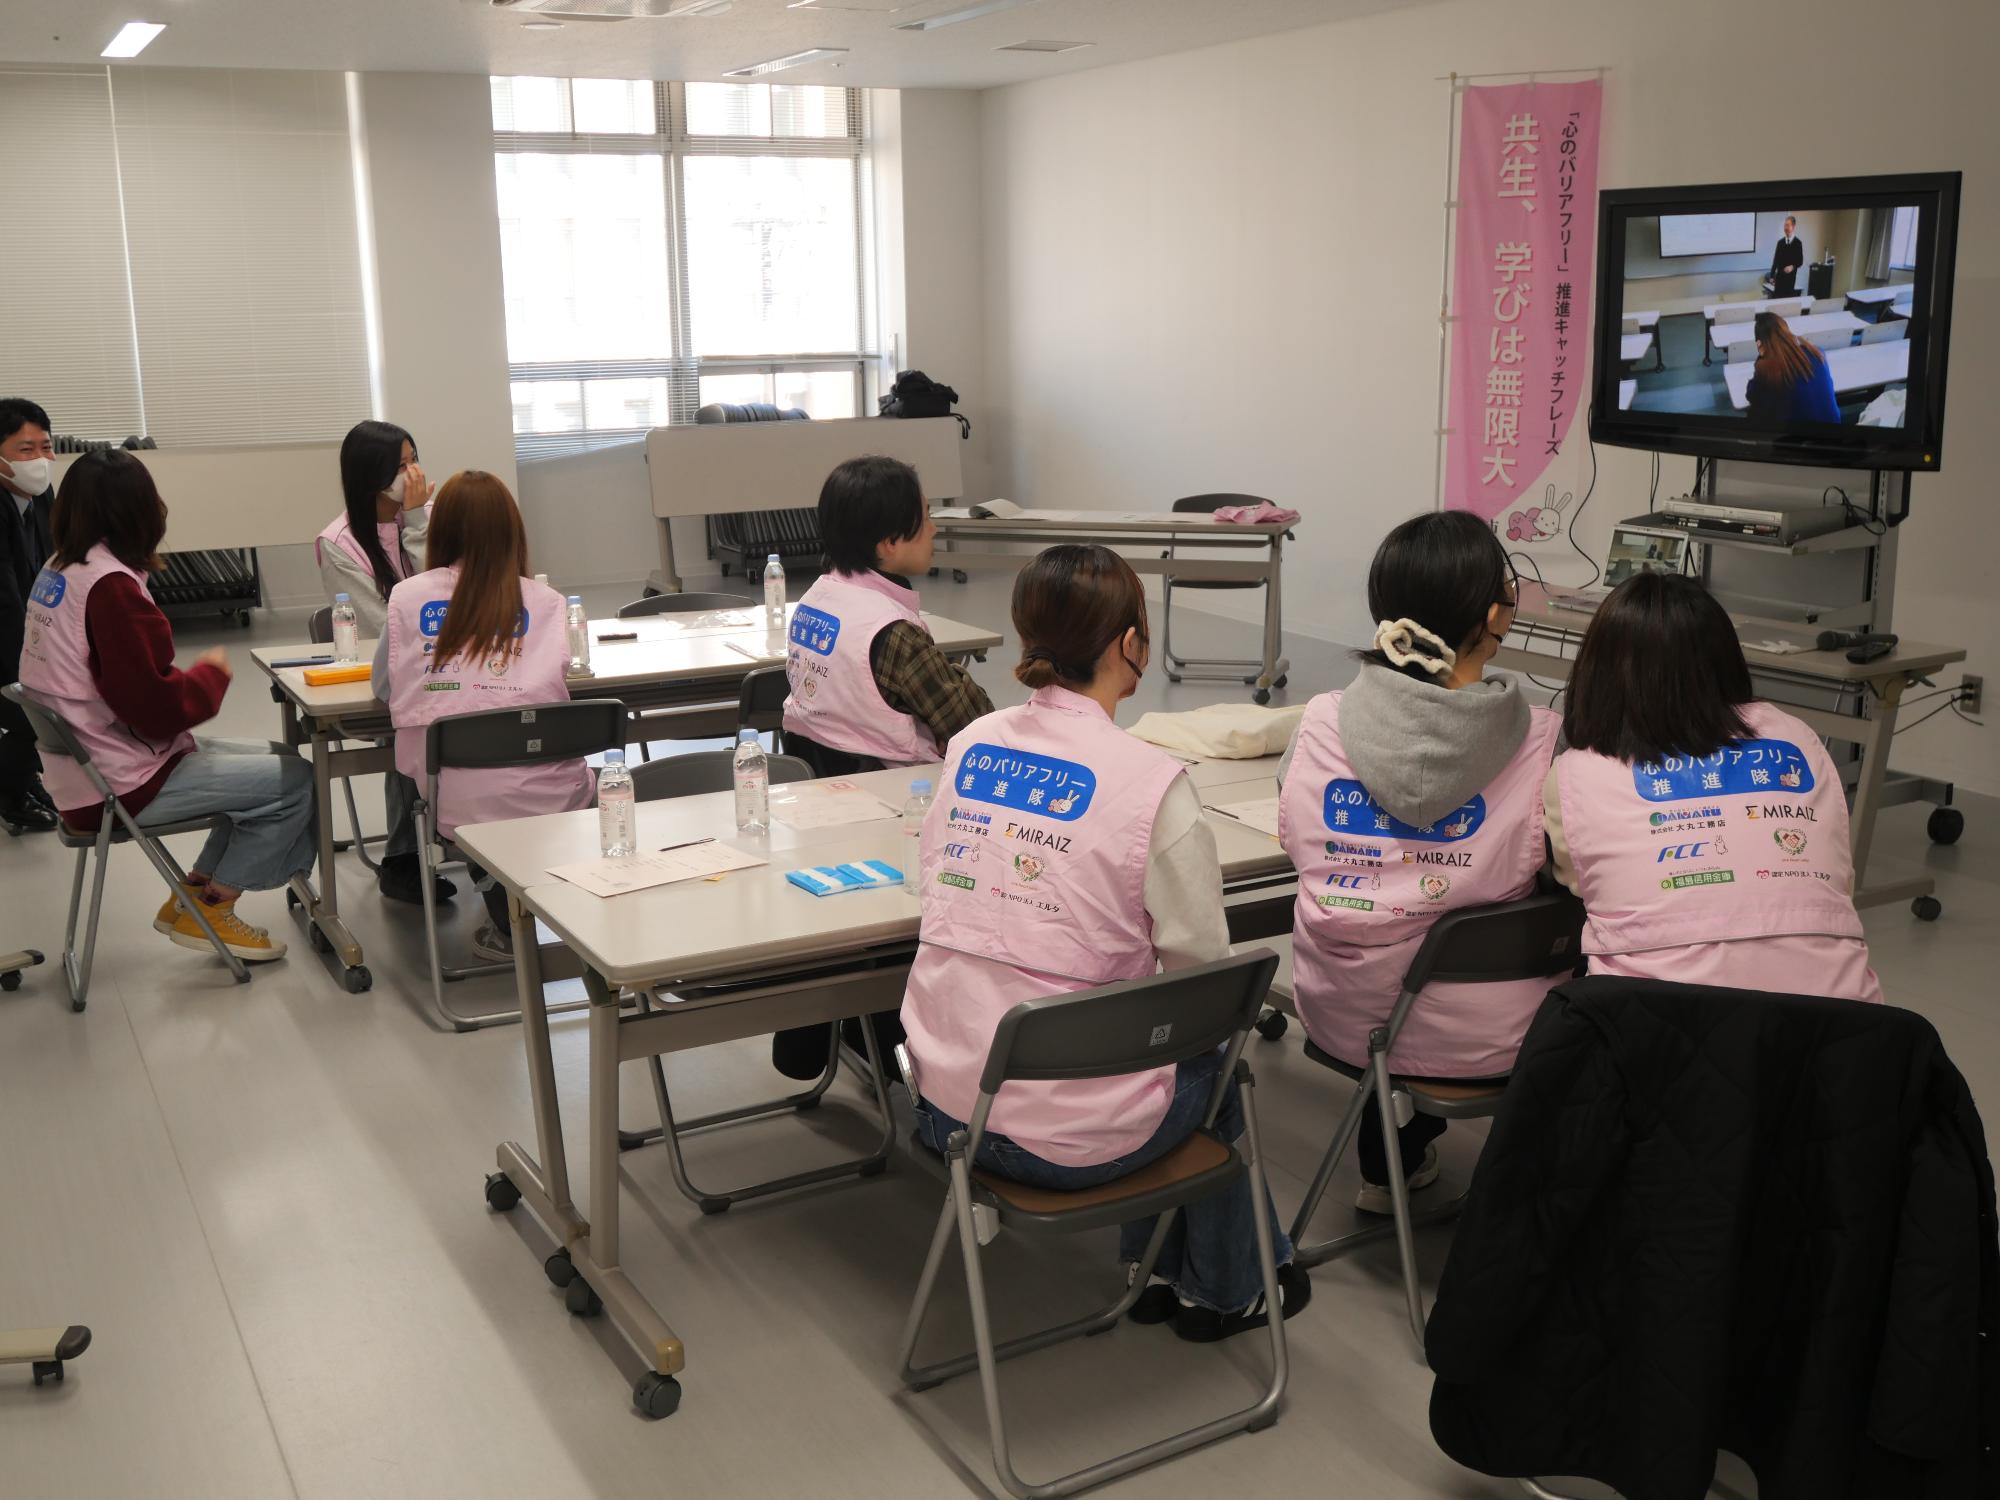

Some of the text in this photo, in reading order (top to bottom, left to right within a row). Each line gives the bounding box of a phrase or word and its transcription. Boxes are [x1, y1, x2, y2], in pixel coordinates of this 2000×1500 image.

[965, 752, 1087, 788] 心のバリアフリー
[1653, 769, 1771, 796] 推進隊
[961, 773, 1045, 805] 推進隊
[1657, 842, 1710, 863] FCC
